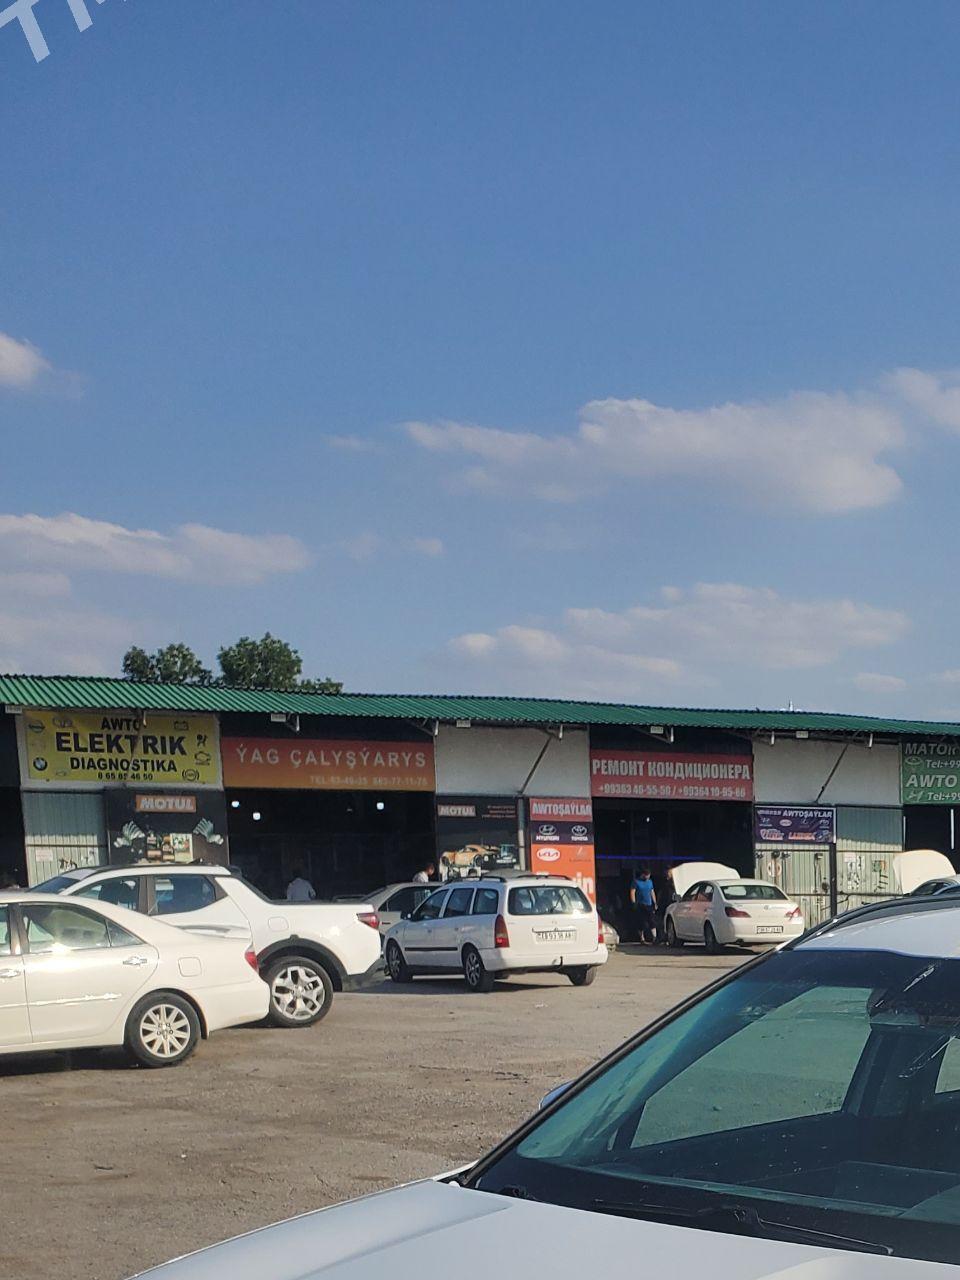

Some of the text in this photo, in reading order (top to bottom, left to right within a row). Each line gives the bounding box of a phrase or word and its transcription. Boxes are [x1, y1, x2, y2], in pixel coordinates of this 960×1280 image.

[55, 732, 187, 756] ELEKTRIK
[236, 744, 426, 769] ÝAG ÇALYŞÝARYS
[70, 757, 177, 773] DIAGNOSTIKA
[592, 759, 750, 780] РЕМОНТ КОНДИЦИОНЕРА
[905, 775, 958, 788] AWTO
[139, 798, 195, 810] MOTUL
[440, 805, 475, 816] MOTUL
